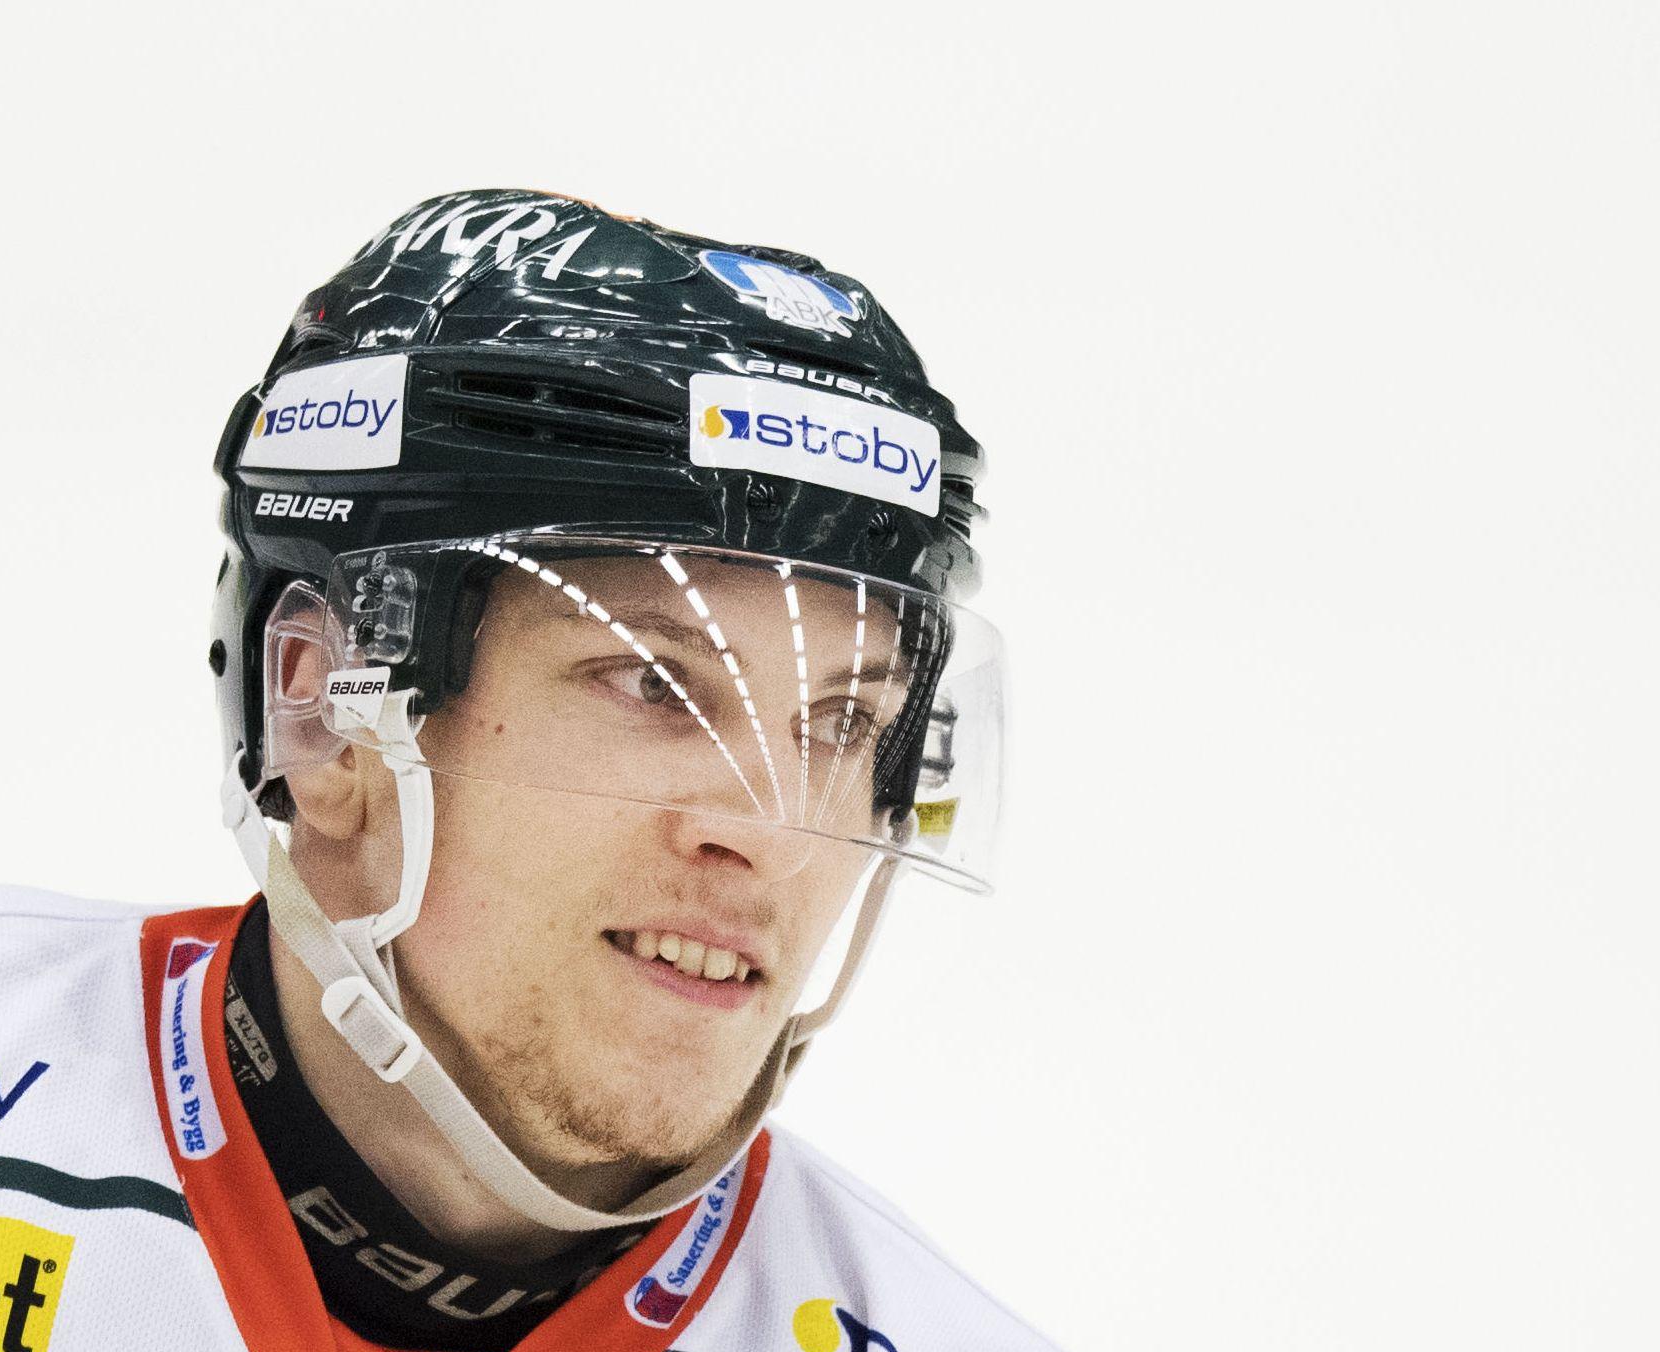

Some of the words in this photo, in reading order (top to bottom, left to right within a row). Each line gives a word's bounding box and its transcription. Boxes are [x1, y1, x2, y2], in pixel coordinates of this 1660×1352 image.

[275, 389, 398, 438] stoby
[756, 405, 937, 494] stoby
[179, 1074, 195, 1094] &
[181, 1096, 206, 1153] Bygg
[666, 1214, 721, 1288] Sanering
[707, 1194, 725, 1212] &
